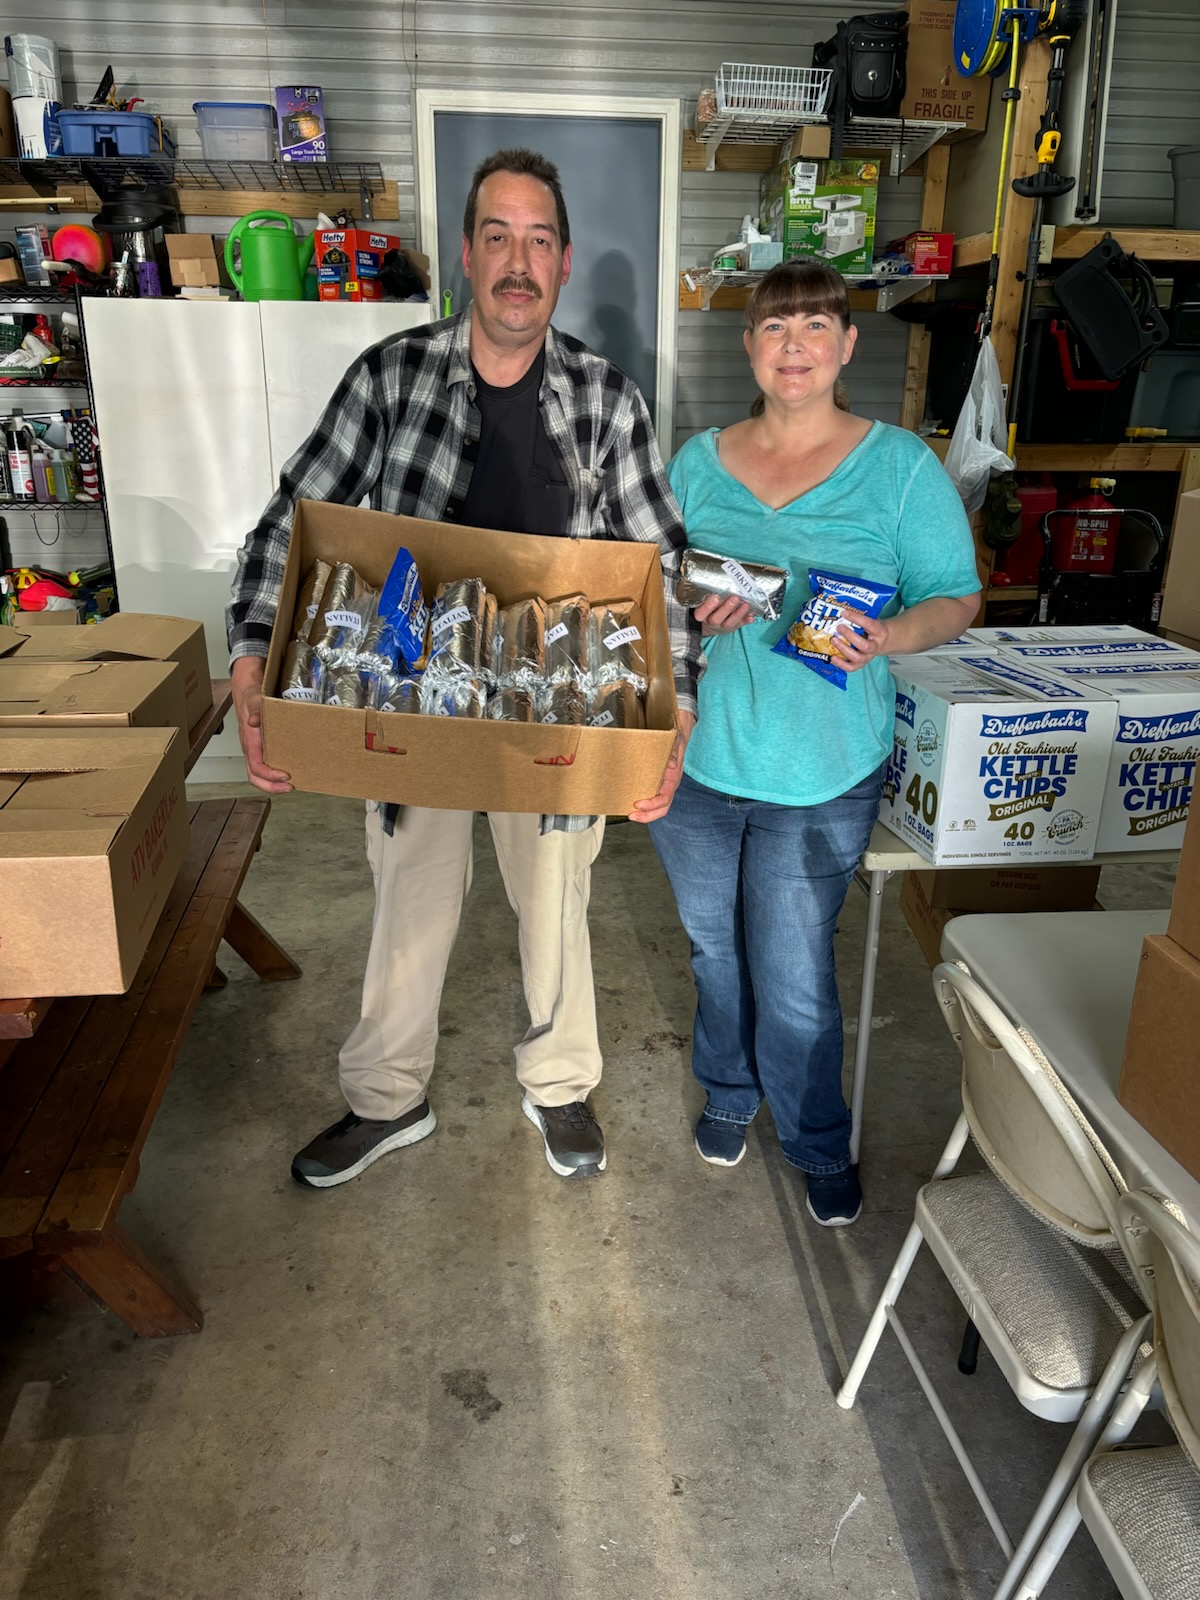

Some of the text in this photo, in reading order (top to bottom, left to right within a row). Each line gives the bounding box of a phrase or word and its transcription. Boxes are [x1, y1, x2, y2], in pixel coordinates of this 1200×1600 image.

[921, 88, 972, 101] THIS SIDE UP
[914, 102, 975, 120] FRAGILE
[312, 140, 325, 150] 90
[322, 232, 345, 243] Hefty
[370, 236, 387, 248] Hefty
[1077, 518, 1109, 528] NO-SPILL
[726, 562, 753, 593] TURKEY
[326, 614, 360, 626] ITALIAN
[434, 610, 469, 632] ITALIAN
[606, 628, 638, 646] ITALIAN
[798, 648, 830, 661] ORIGINAL
[983, 710, 1084, 736] Dieffenbach's
[987, 741, 1079, 755] Old Fashioned
[1128, 746, 1156, 763] Old
[978, 754, 1079, 777] KETTLE
[1017, 771, 1039, 781] POTATO
[983, 776, 1068, 799] CHIPS
[1162, 780, 1186, 791] POTATO
[906, 772, 938, 827] 40
[995, 795, 1050, 817] ORIGINAL
[904, 811, 908, 823] 1
[917, 822, 935, 844] BAGS
[1003, 821, 1036, 841] 40
[1046, 815, 1084, 839] Crunch
[997, 871, 1039, 880] RETURN BOX
[990, 880, 1041, 891] OR PAY DEPOSIT
